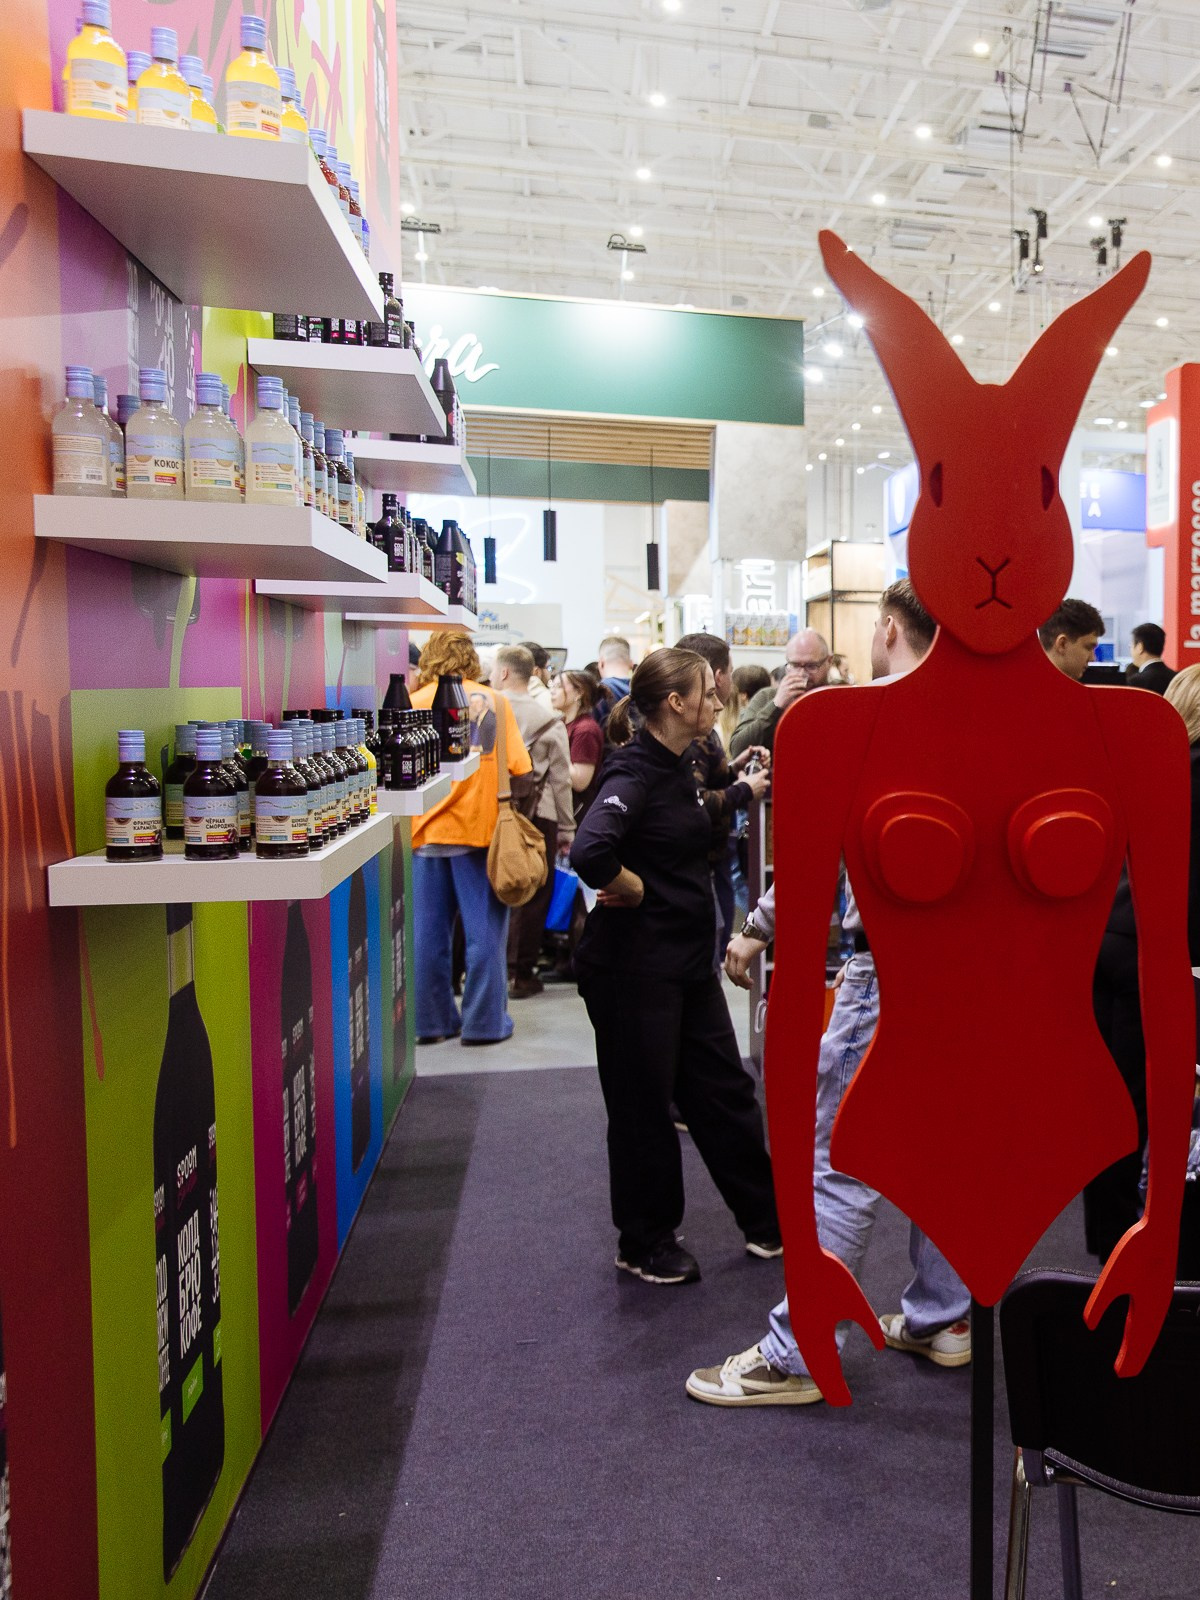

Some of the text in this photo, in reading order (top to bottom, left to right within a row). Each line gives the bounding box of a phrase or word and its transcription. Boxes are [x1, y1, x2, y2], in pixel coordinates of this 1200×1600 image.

[154, 459, 179, 470] КОКОС
[177, 1145, 198, 1189] SPOOM
[177, 1209, 200, 1272] КОЛД
[179, 1249, 202, 1321] БРЮ
[181, 1293, 203, 1360] КОФЕ
